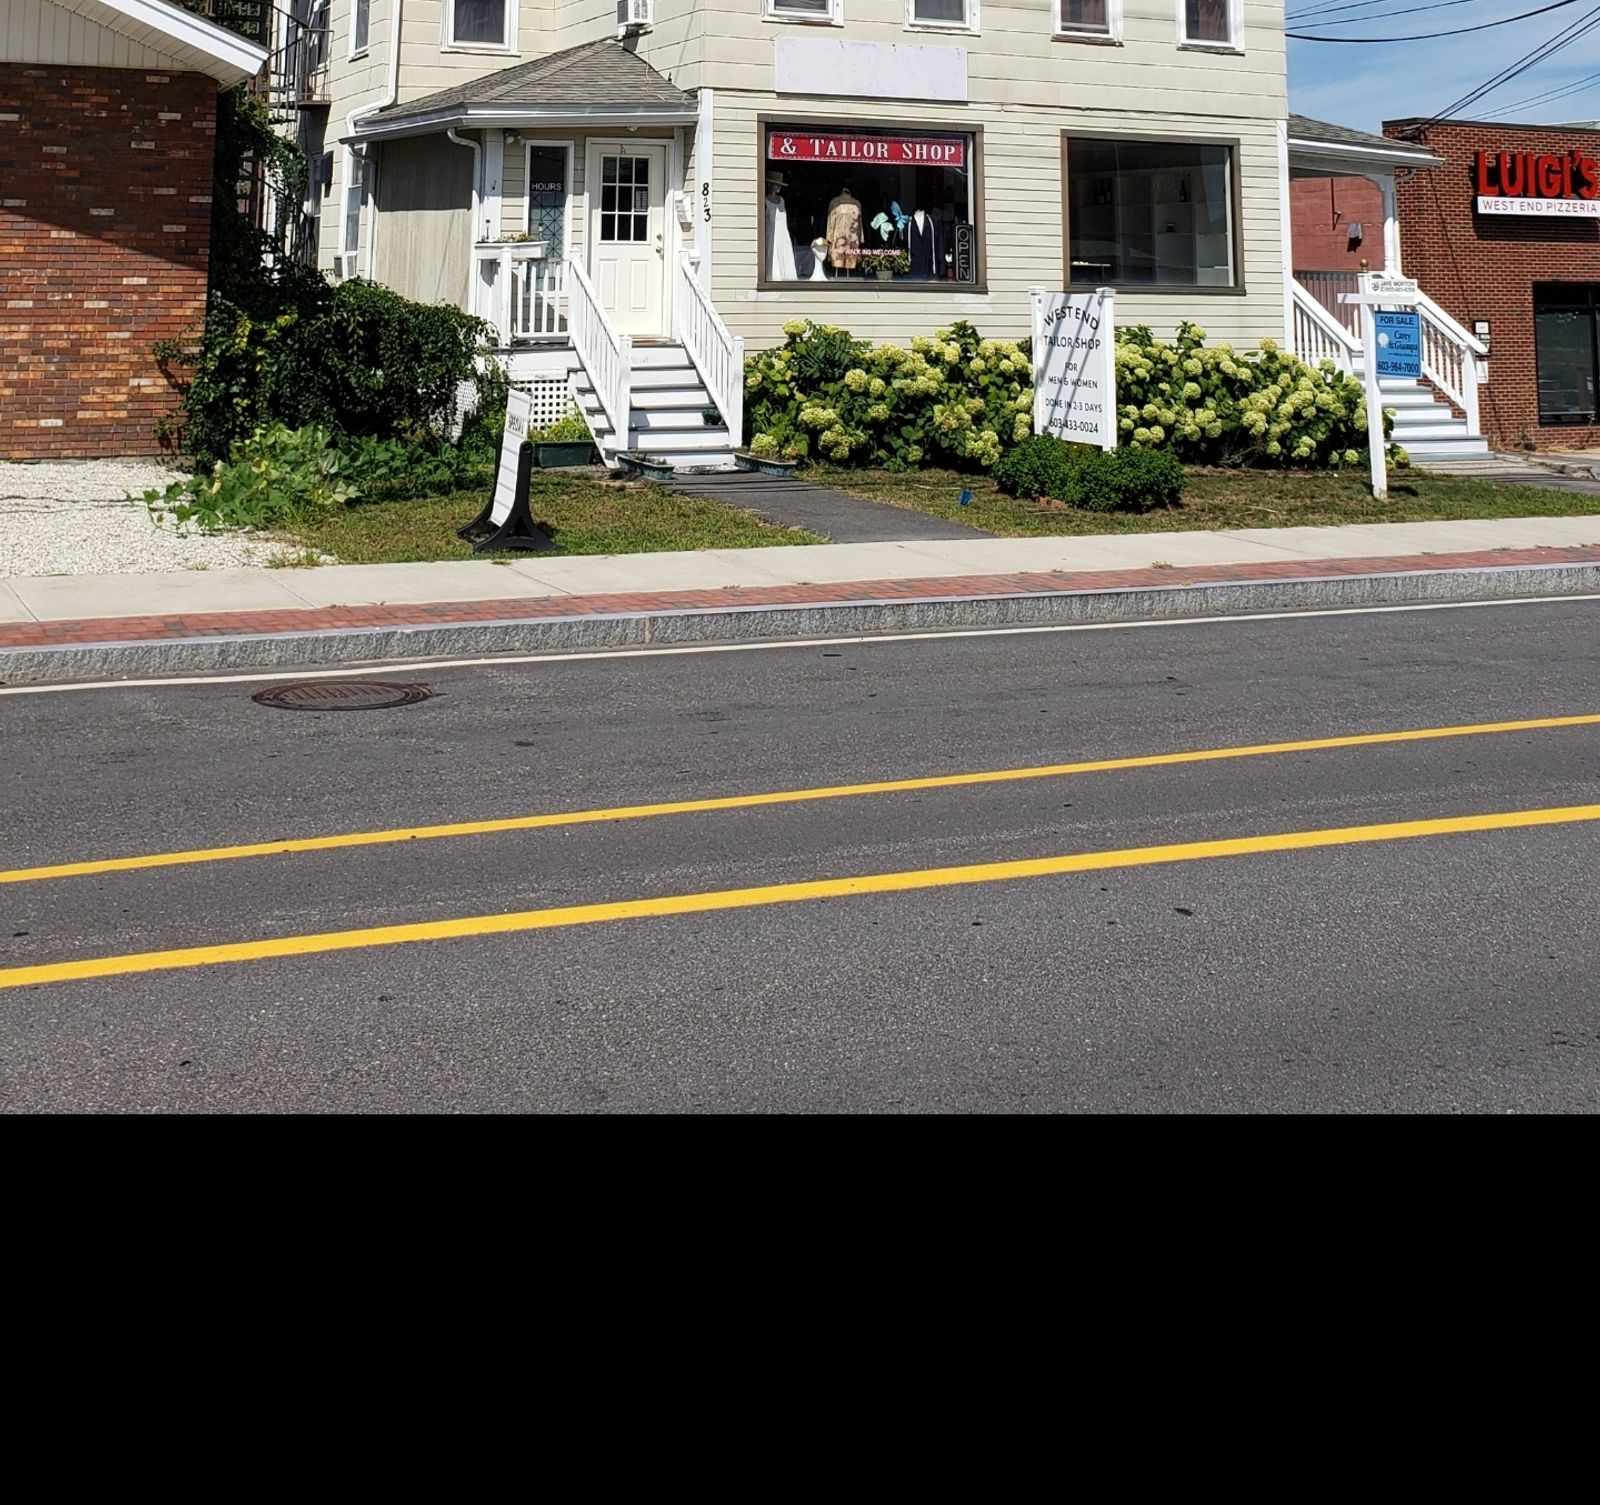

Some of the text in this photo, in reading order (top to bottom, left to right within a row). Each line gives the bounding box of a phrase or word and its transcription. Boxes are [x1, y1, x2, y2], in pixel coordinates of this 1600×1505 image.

[780, 137, 956, 161] & TAILOR SHOP
[1478, 149, 1599, 199] LUIGI'S
[531, 182, 562, 191] HOURS
[701, 182, 712, 222] 823
[1482, 199, 1598, 213] WEST END PIZZERIA
[957, 228, 970, 280] OPEN
[1043, 306, 1099, 331] WEST END
[1380, 315, 1415, 326] FOR SALE
[1043, 335, 1101, 350] TAILOR SHOP
[1065, 362, 1078, 372] FOR
[1048, 376, 1063, 385] MEN
[1071, 378, 1098, 389] WOMEN
[1045, 398, 1103, 413] DONE IN 2-3 DAYS
[1049, 417, 1099, 434] 603-433-0024
